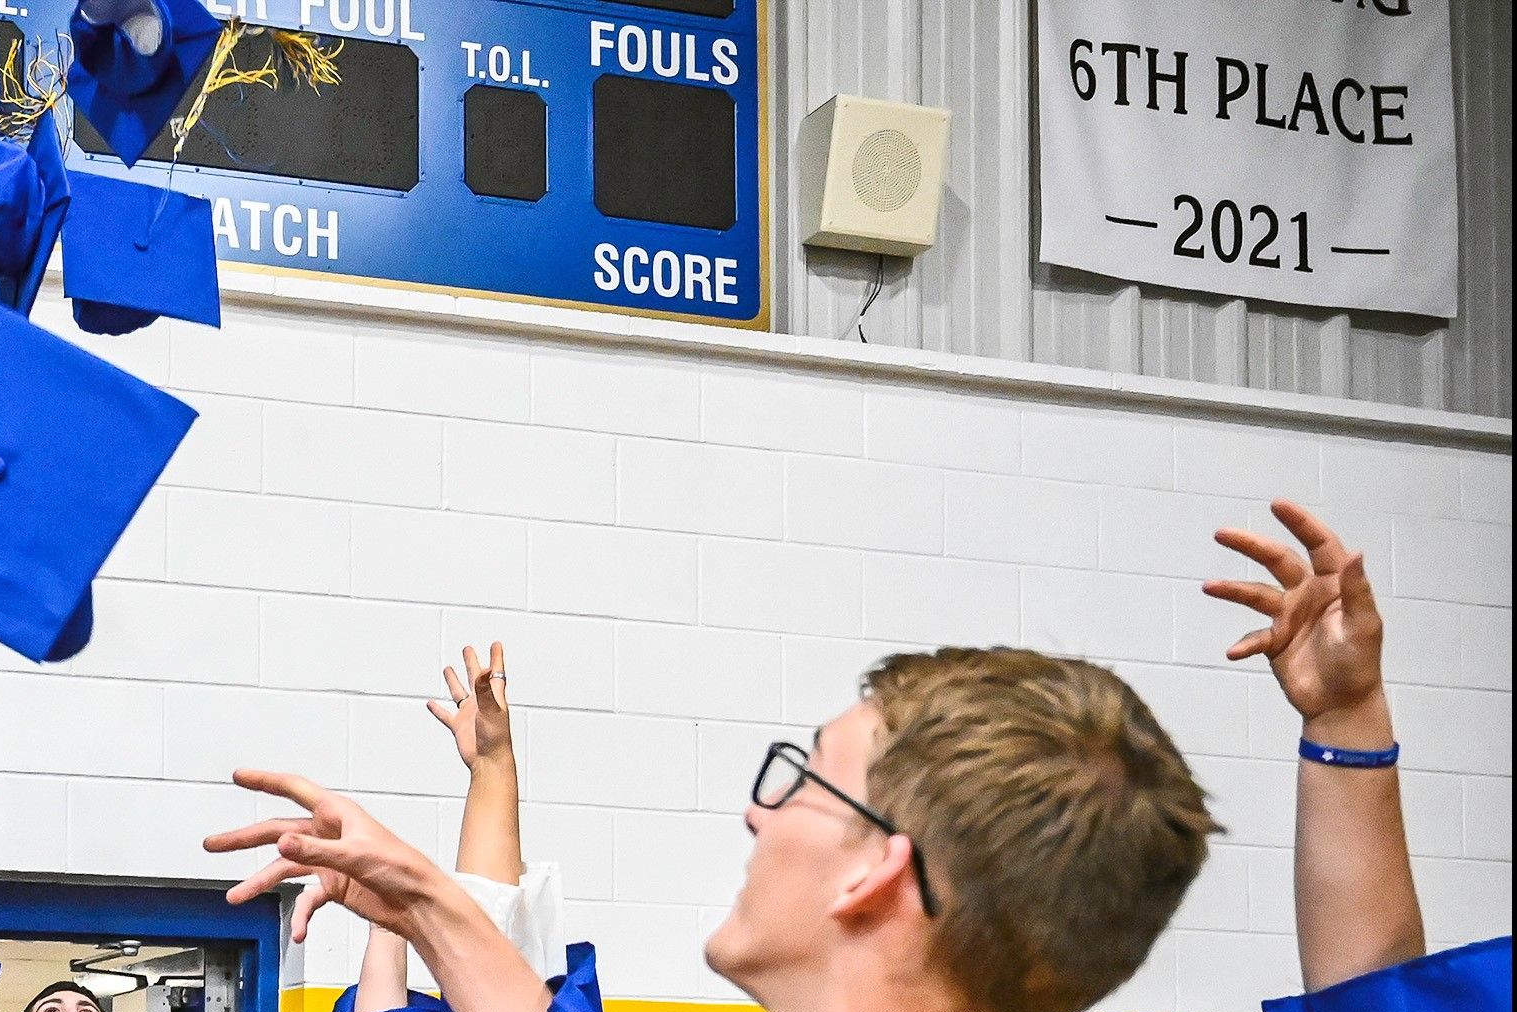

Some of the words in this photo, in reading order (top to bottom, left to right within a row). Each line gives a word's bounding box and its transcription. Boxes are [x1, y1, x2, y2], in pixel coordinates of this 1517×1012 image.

[460, 41, 550, 88] T.O.L.
[590, 20, 740, 85] FOULS
[1069, 38, 1189, 114] 6TH
[1215, 56, 1413, 146] PLACE
[212, 197, 340, 260] ATCH
[1173, 193, 1314, 273] 2021
[593, 242, 740, 304] SCORE
